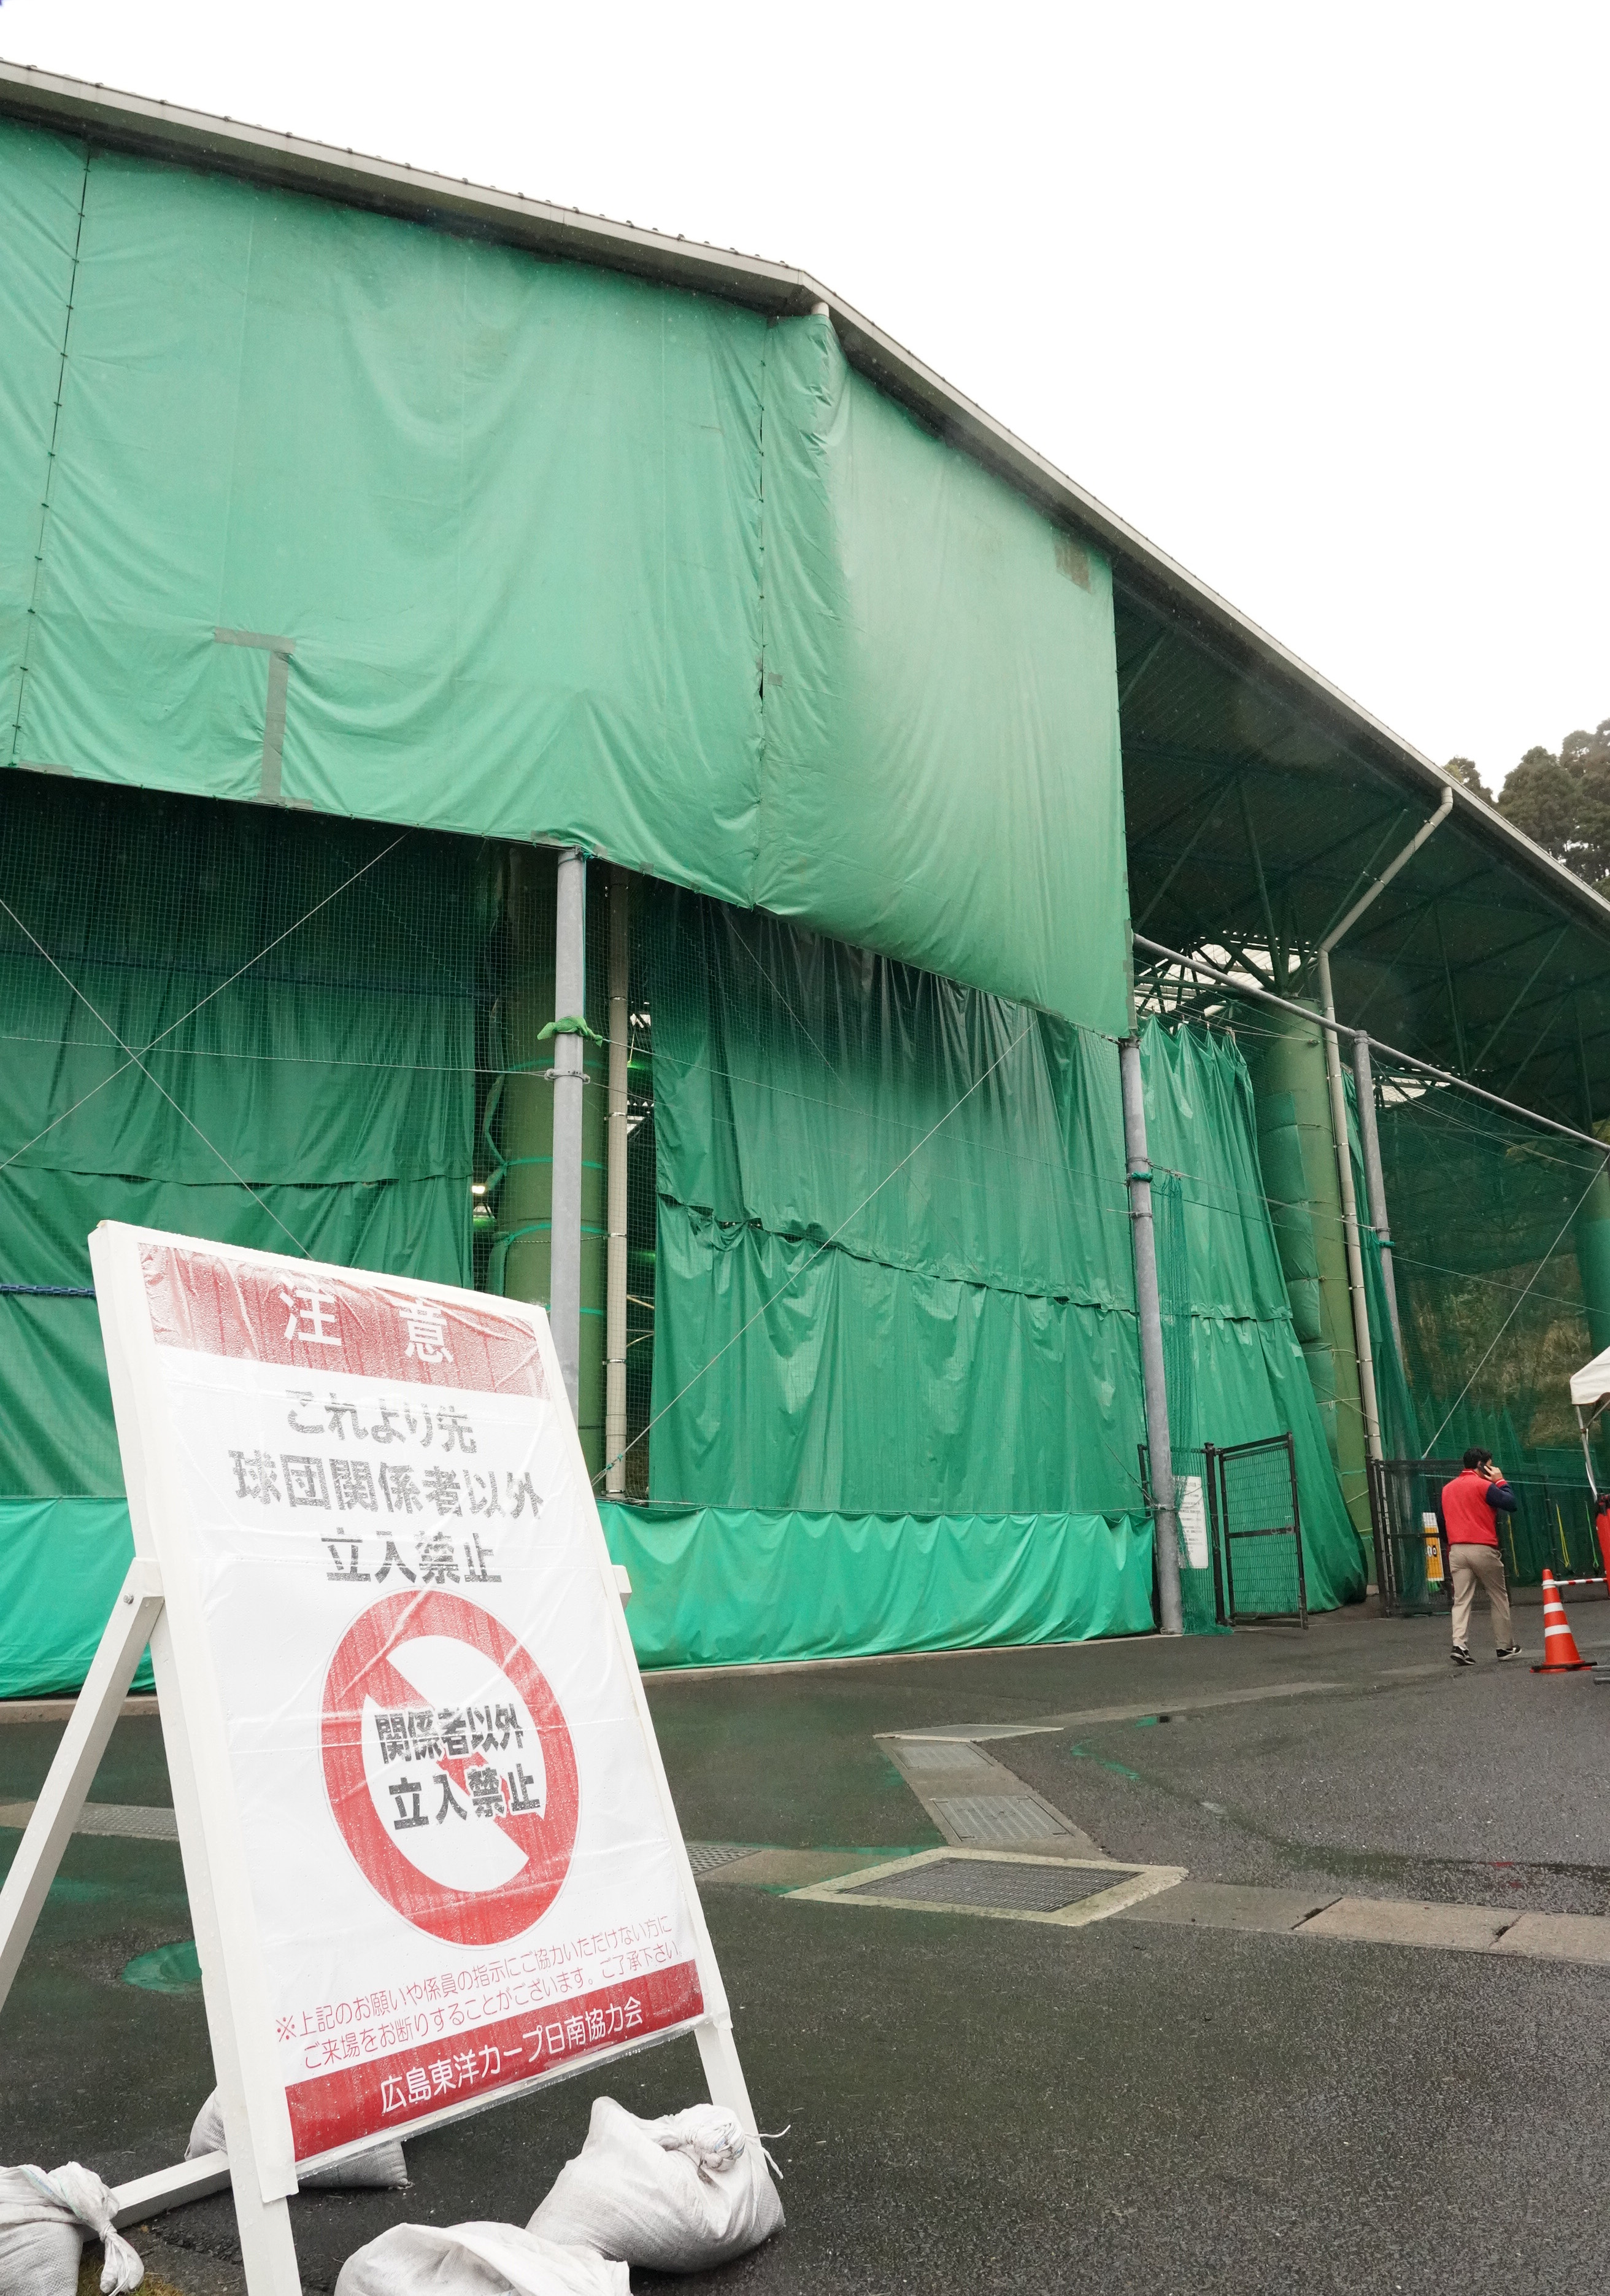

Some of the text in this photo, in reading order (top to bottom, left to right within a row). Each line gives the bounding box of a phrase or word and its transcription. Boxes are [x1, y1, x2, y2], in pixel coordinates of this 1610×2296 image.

[285, 1390, 476, 1453] これより先
[228, 1449, 544, 1519] 球団関係者以外
[321, 1528, 502, 1583] 立入禁止
[374, 1703, 523, 1763] 関係者以外
[388, 1763, 540, 1830] 立入禁止
[382, 1996, 642, 2112] 広島東洋カープ日南協力会
